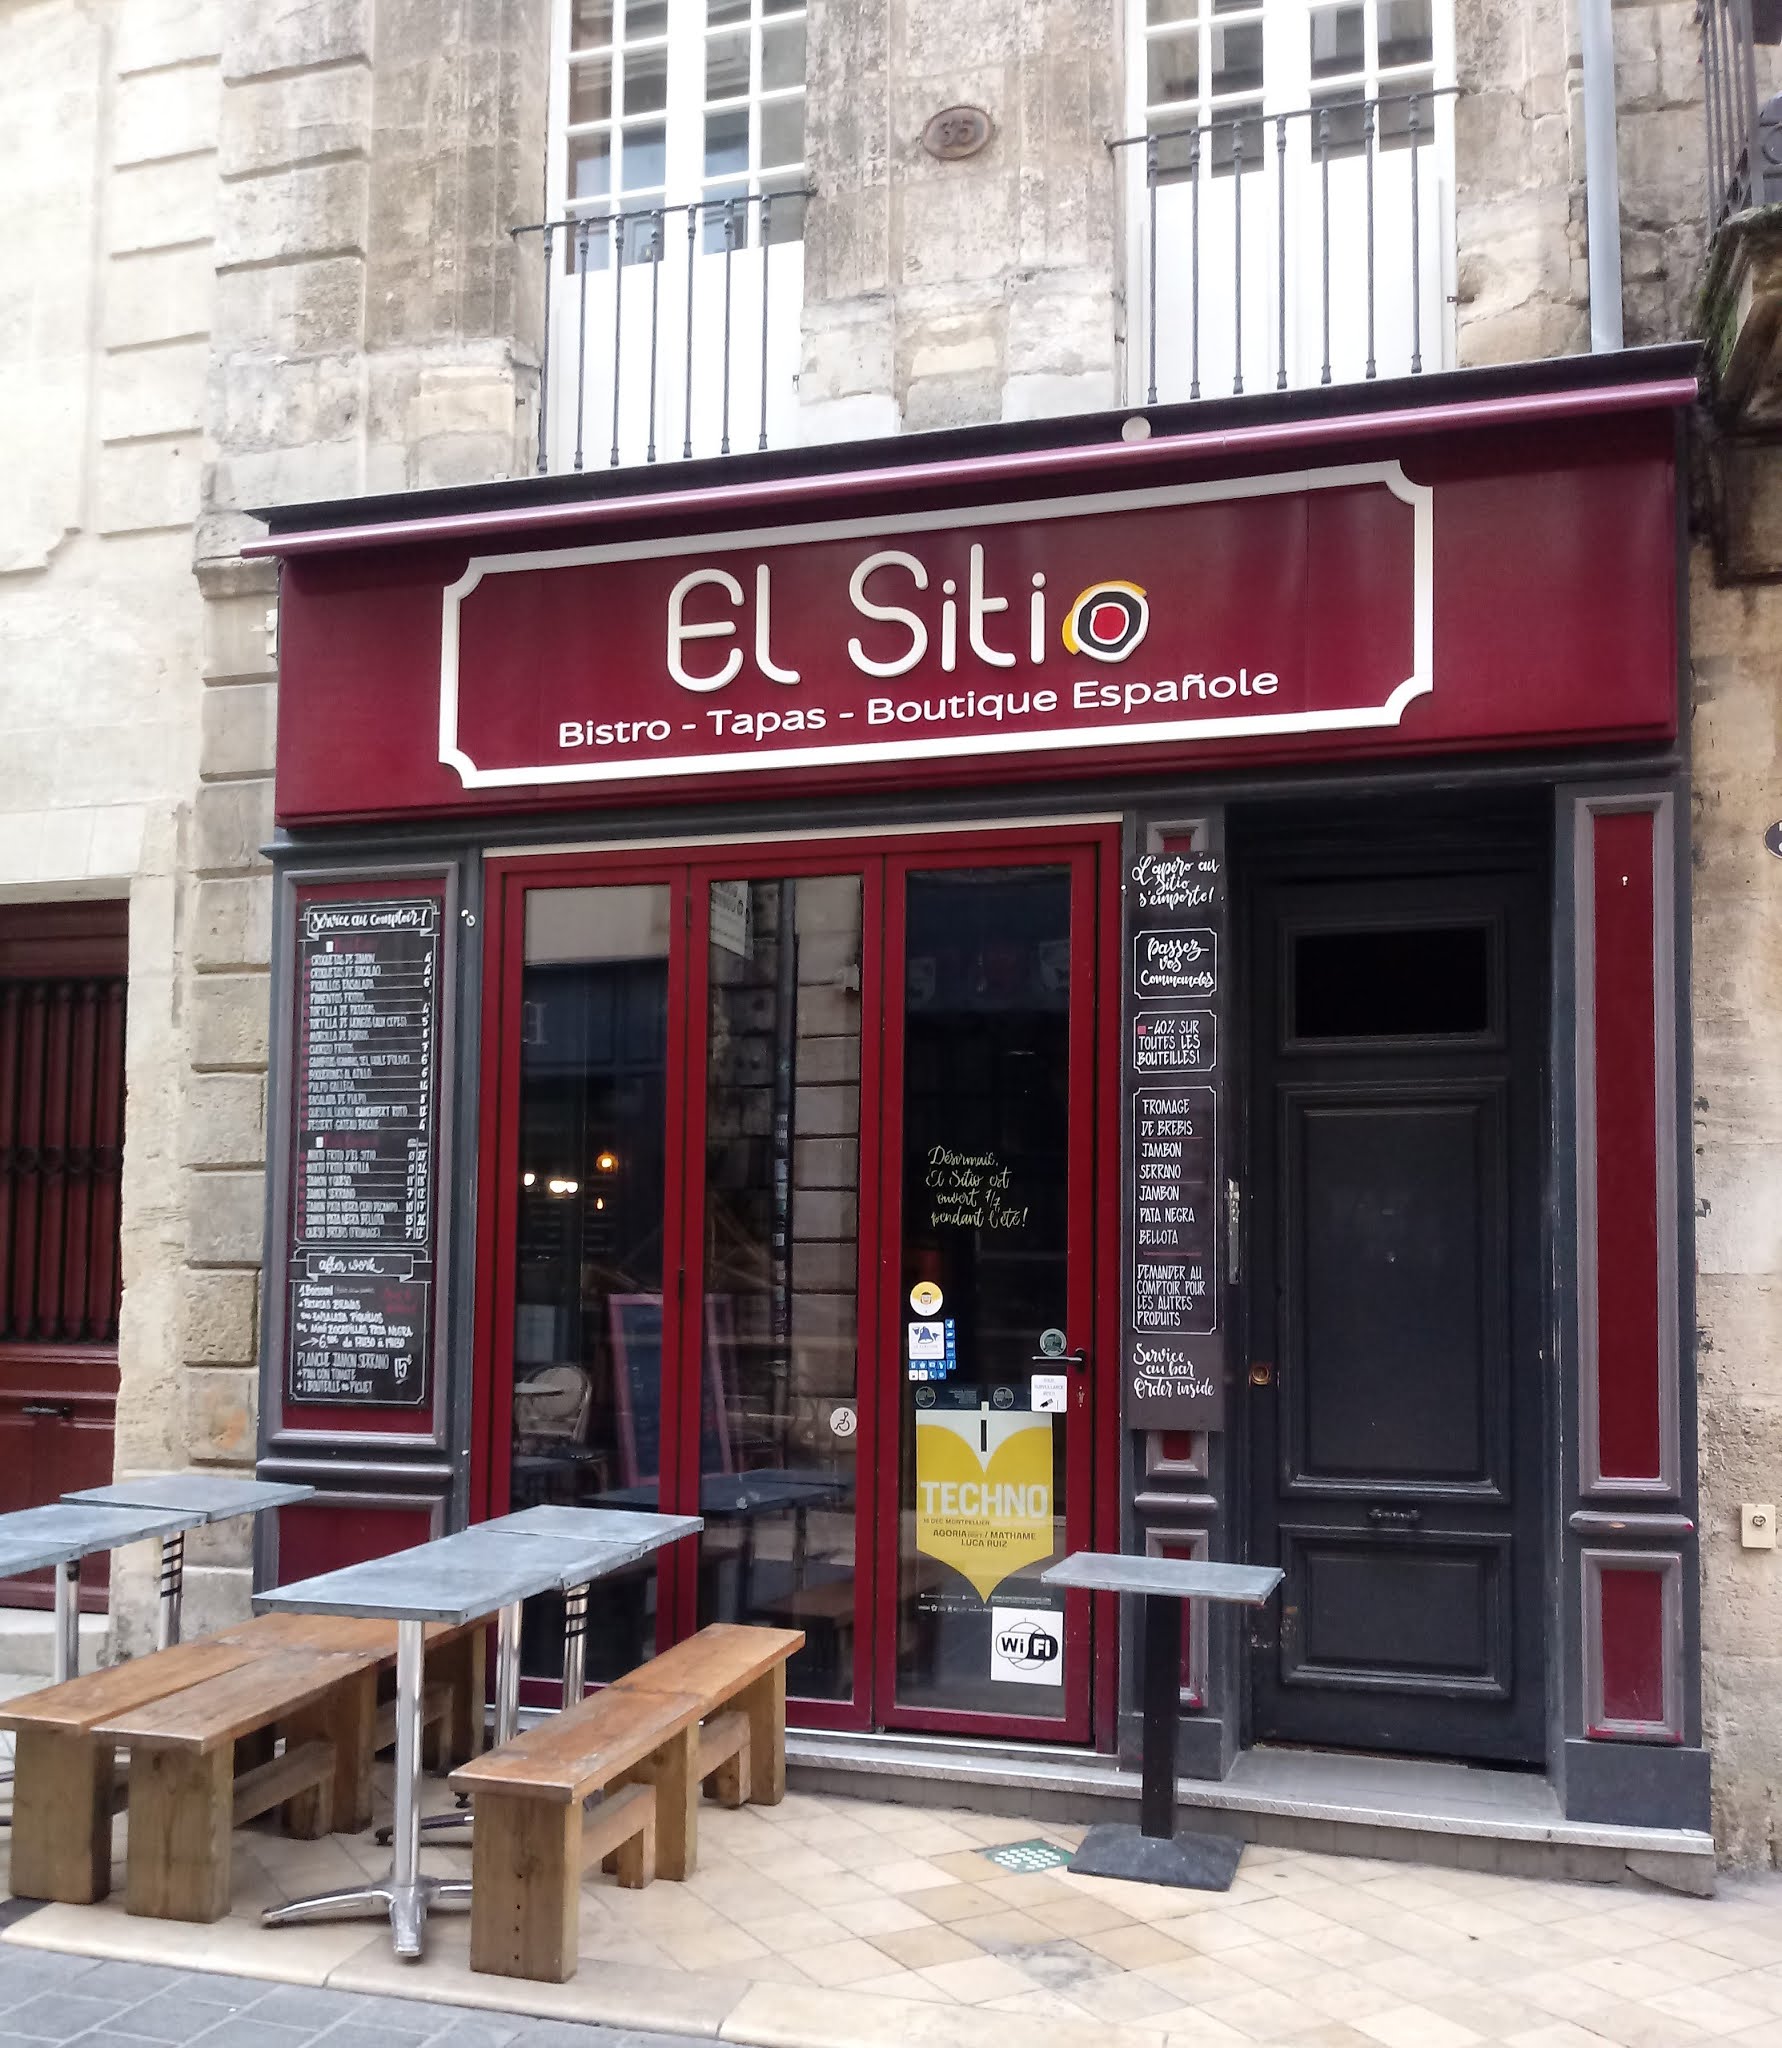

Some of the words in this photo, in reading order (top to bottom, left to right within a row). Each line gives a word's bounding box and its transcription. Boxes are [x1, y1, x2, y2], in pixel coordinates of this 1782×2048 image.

[847, 543, 1150, 679] Sitio
[559, 714, 671, 750] Bistro
[707, 706, 828, 741] Tapas
[868, 687, 1059, 726] Boutique
[1072, 668, 1280, 715] Españole
[1198, 858, 1221, 875] au
[311, 911, 349, 932] Service
[1178, 1019, 1200, 1035] SUR
[1138, 1035, 1176, 1051] TOUTES
[1180, 1034, 1201, 1050] LES
[1141, 1098, 1191, 1116] FROMAGE
[1141, 1120, 1155, 1137] DE
[1157, 1120, 1194, 1137] BREBIS
[1141, 1141, 1183, 1158] JAMBON
[989, 1165, 1012, 1189] est
[1139, 1164, 1182, 1180] SERRANO
[936, 1187, 981, 1208] ouvert
[1139, 1185, 1180, 1201] JAMBON
[930, 1205, 985, 1228] pendant
[1140, 1207, 1162, 1223] PATA
[1164, 1207, 1195, 1223] NEGRA
[1138, 1229, 1179, 1245] BELLOTA
[318, 1255, 347, 1275] after
[1137, 1264, 1186, 1281] DEMANDER
[1190, 1265, 1202, 1281] AU
[1136, 1279, 1181, 1296] COMPTOIR
[1184, 1280, 1206, 1297] POUR
[1137, 1295, 1154, 1310] LES
[1157, 1295, 1194, 1311] AUTRES
[1137, 1311, 1182, 1327] PRODUITS
[1132, 1342, 1186, 1366] Service
[1145, 1363, 1166, 1376] au
[1168, 1360, 1195, 1378] bar
[1133, 1376, 1173, 1399] Order
[1176, 1376, 1215, 1399] inside
[920, 1481, 1049, 1520] TECHNO
[933, 1529, 967, 1538] AGORIA
[990, 1531, 1037, 1541] MATHAME
[960, 1539, 985, 1548] LUCA
[986, 1540, 1008, 1548] RUIZ
